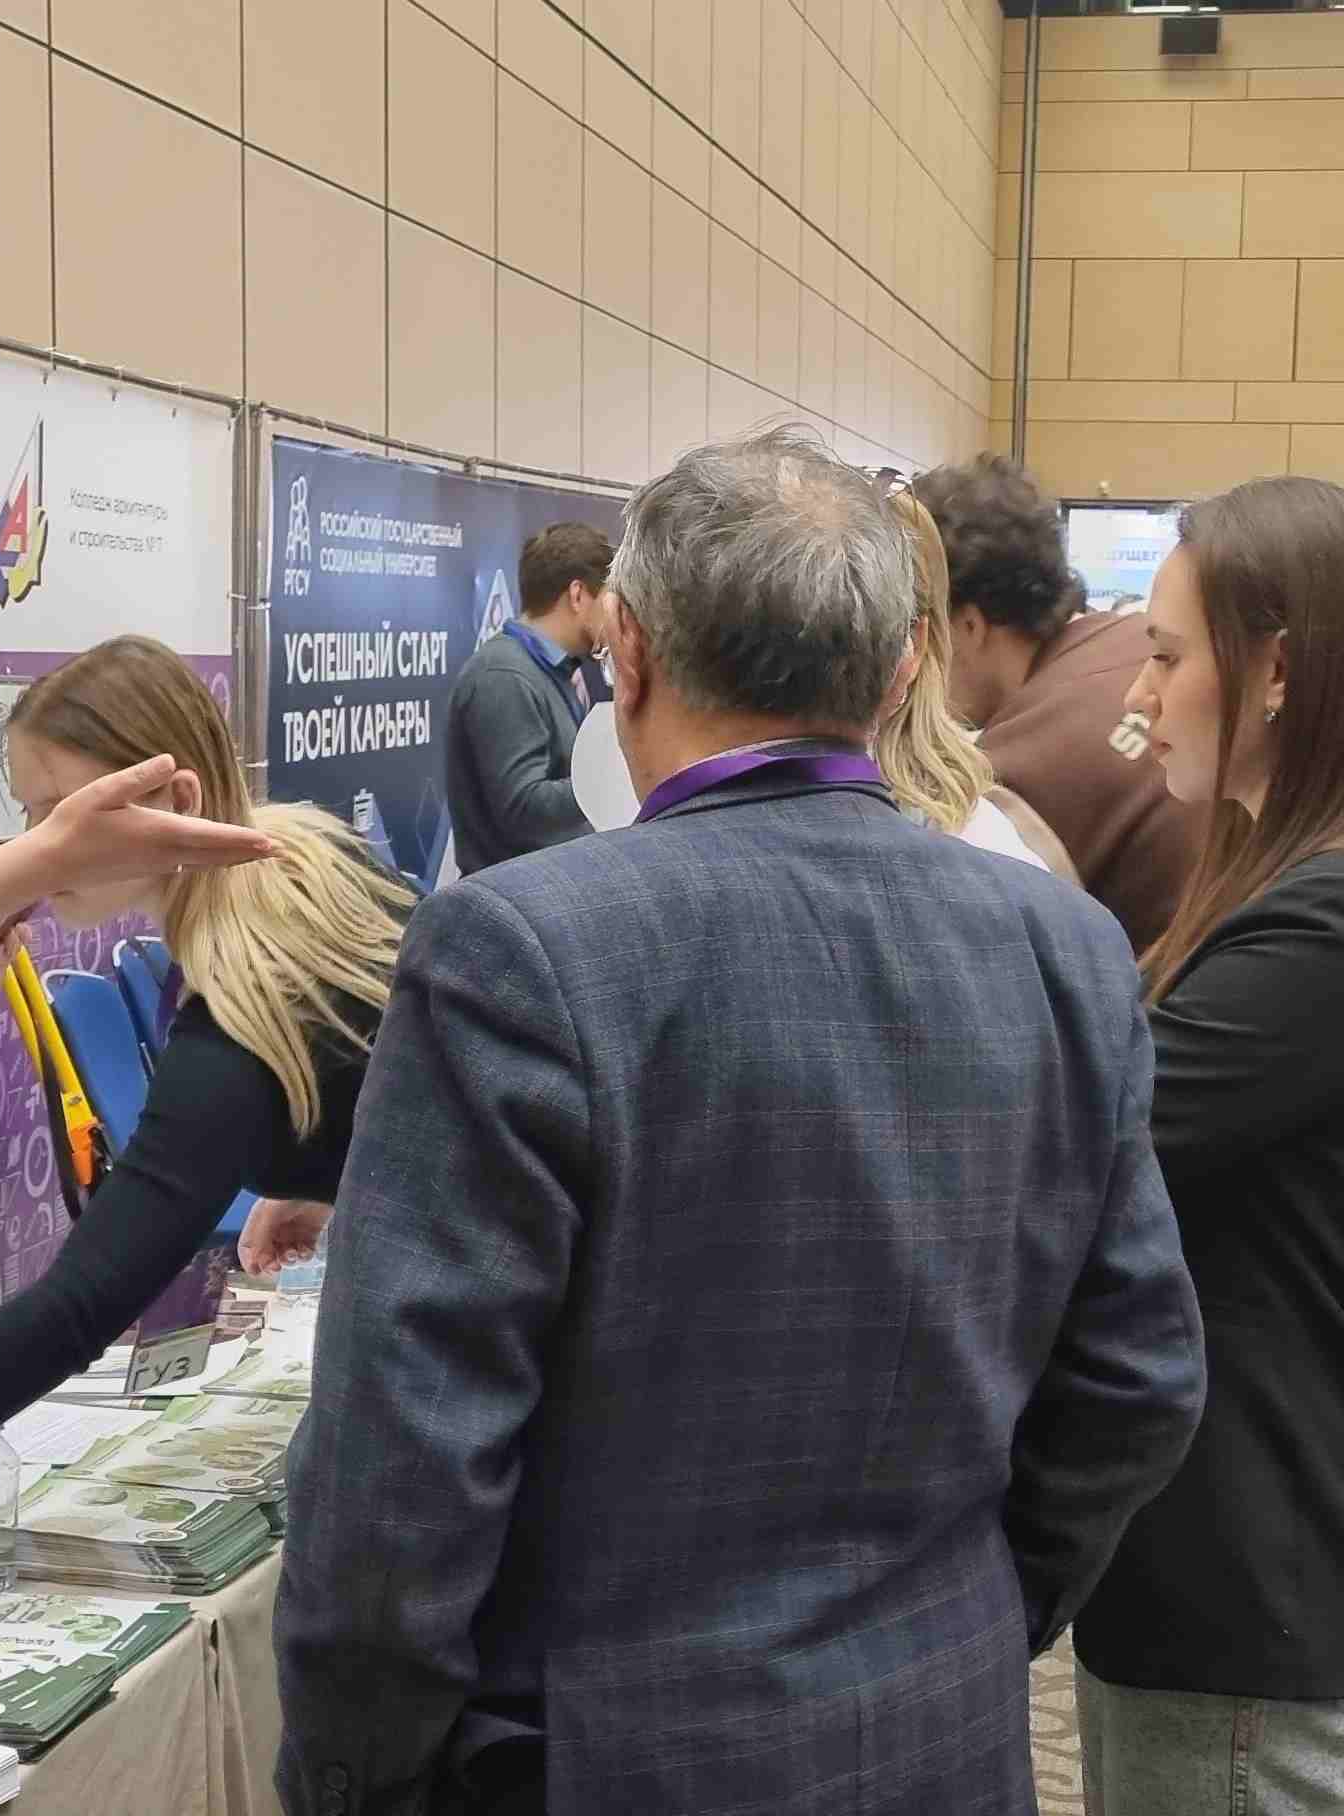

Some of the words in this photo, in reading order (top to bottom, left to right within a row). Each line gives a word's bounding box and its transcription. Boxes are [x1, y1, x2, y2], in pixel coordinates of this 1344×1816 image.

[284, 568, 311, 595] РГСУ
[284, 620, 393, 684] УСПЕШНЫЙ
[397, 631, 448, 677] СТАРТ
[283, 695, 346, 763] ТВОЕЙ
[350, 700, 430, 754] КАРЬЕРЫ
[133, 1356, 191, 1392] ГУЗ
